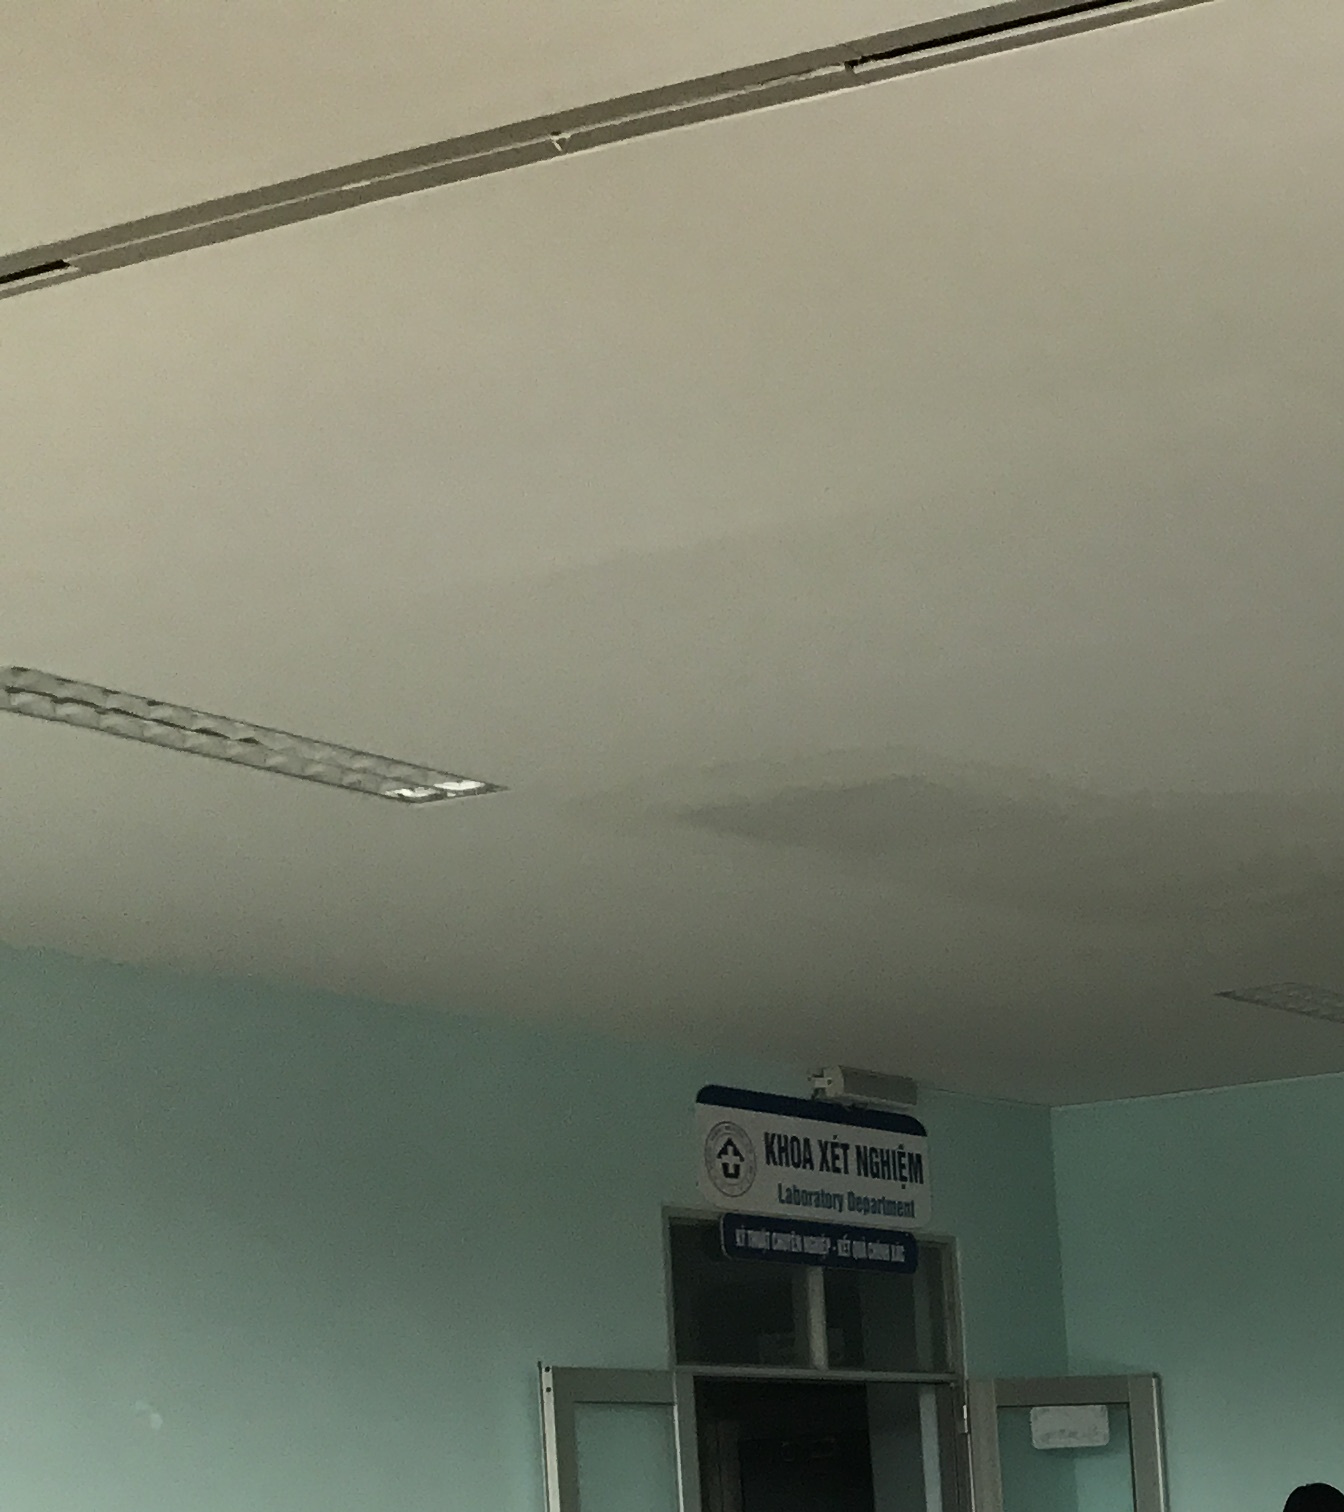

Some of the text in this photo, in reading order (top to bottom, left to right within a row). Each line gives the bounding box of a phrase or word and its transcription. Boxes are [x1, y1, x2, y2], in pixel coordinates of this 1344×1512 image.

[764, 1132, 924, 1189] KHOA XÉT NGHIỆM
[778, 1183, 915, 1218] Laboratory Department
